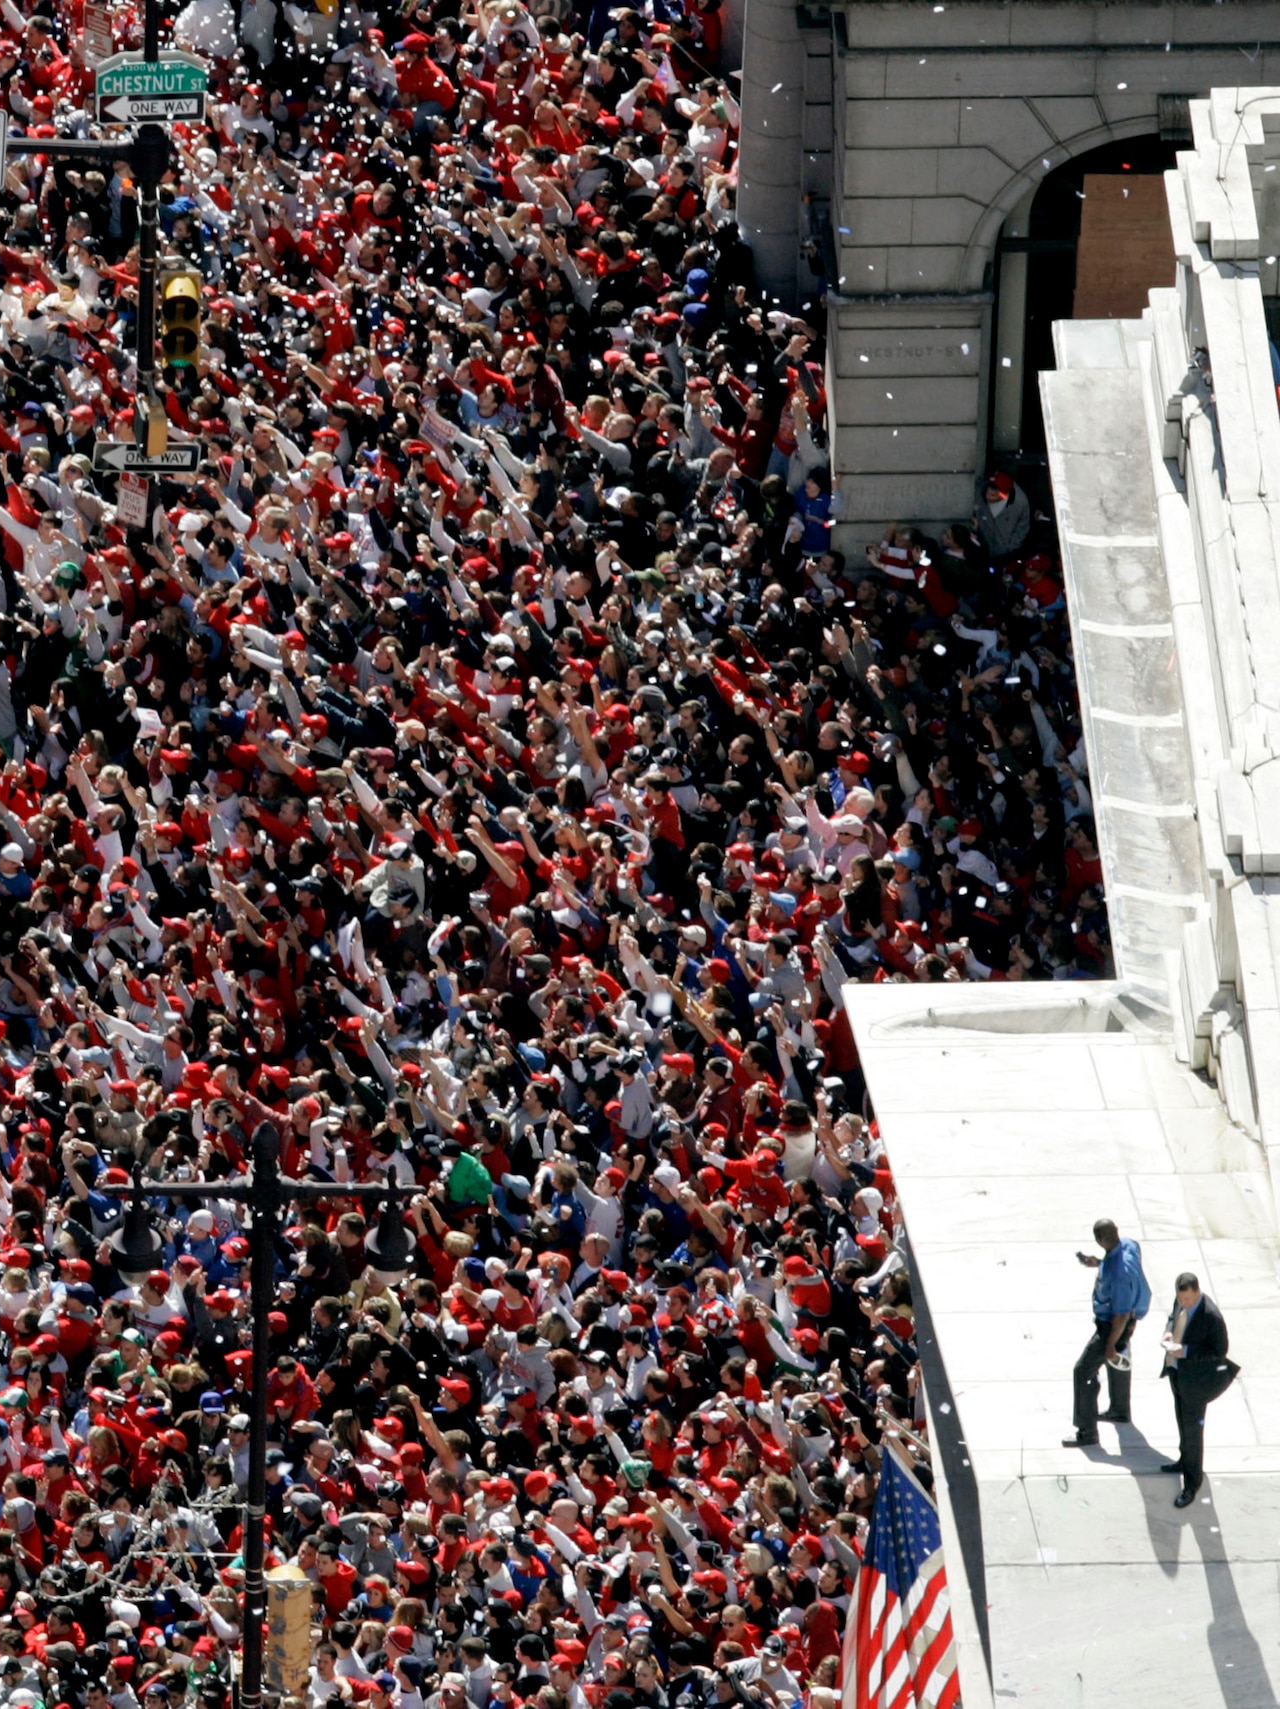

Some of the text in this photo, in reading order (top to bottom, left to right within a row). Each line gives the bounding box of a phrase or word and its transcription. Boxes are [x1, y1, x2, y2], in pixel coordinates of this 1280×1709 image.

[146, 62, 158, 72] W
[101, 74, 204, 93] CHESTNUT ST
[130, 100, 193, 114] ONE WAY
[161, 452, 187, 464] WAY
[124, 491, 140, 504] BUS
[121, 500, 142, 513] ZONE
